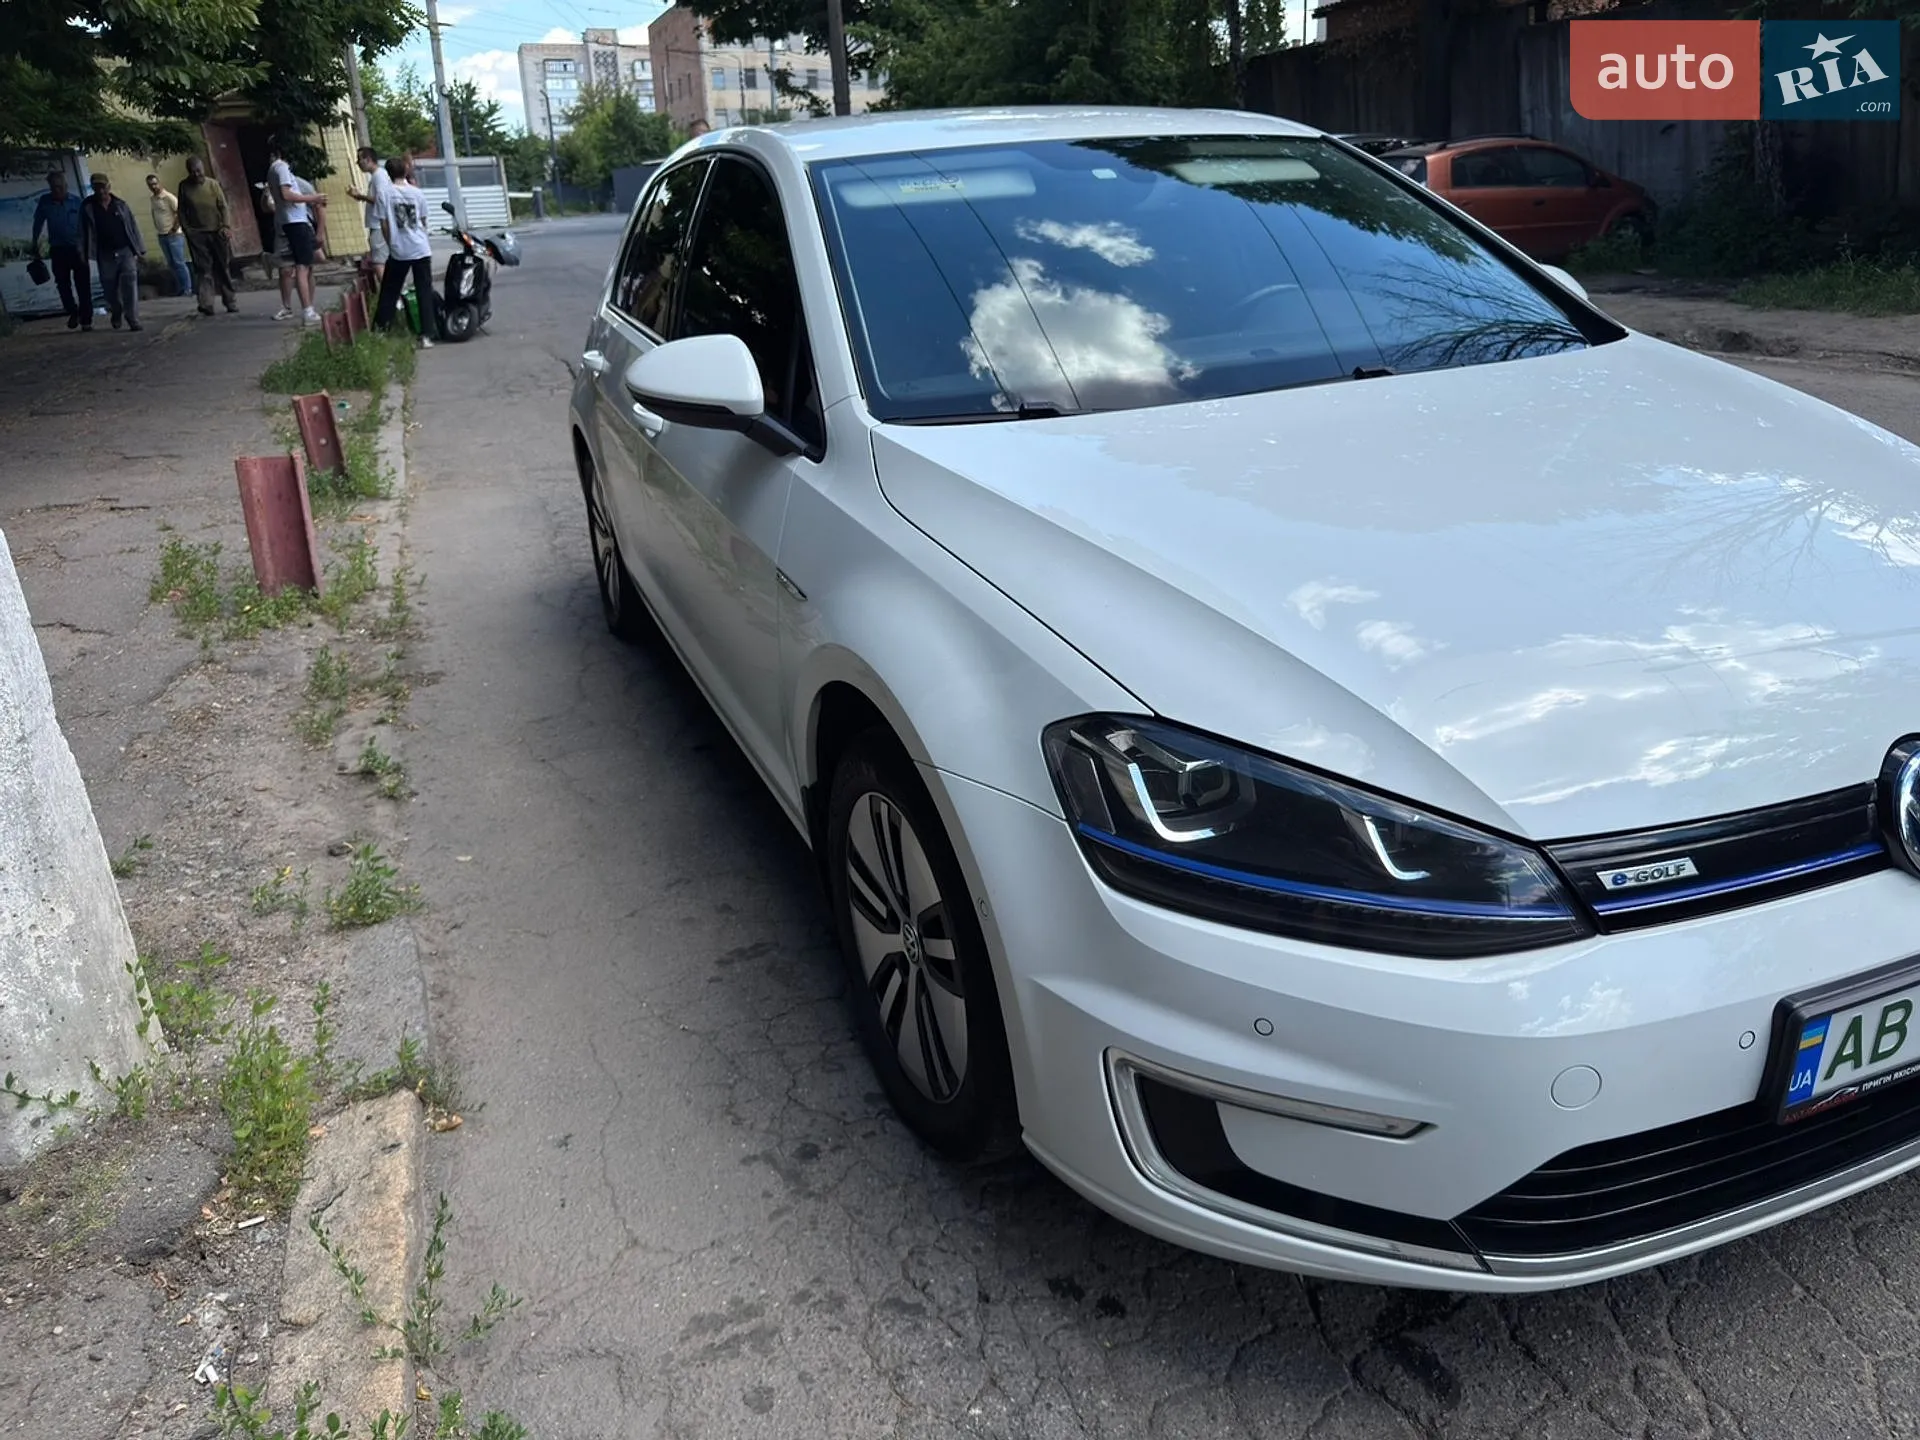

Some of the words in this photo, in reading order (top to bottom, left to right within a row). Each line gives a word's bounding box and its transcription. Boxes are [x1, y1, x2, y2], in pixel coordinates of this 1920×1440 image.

[1611, 863, 1686, 886] e-GOLF
[1825, 999, 1914, 1080] AB
[1789, 1069, 1812, 1091] UA
